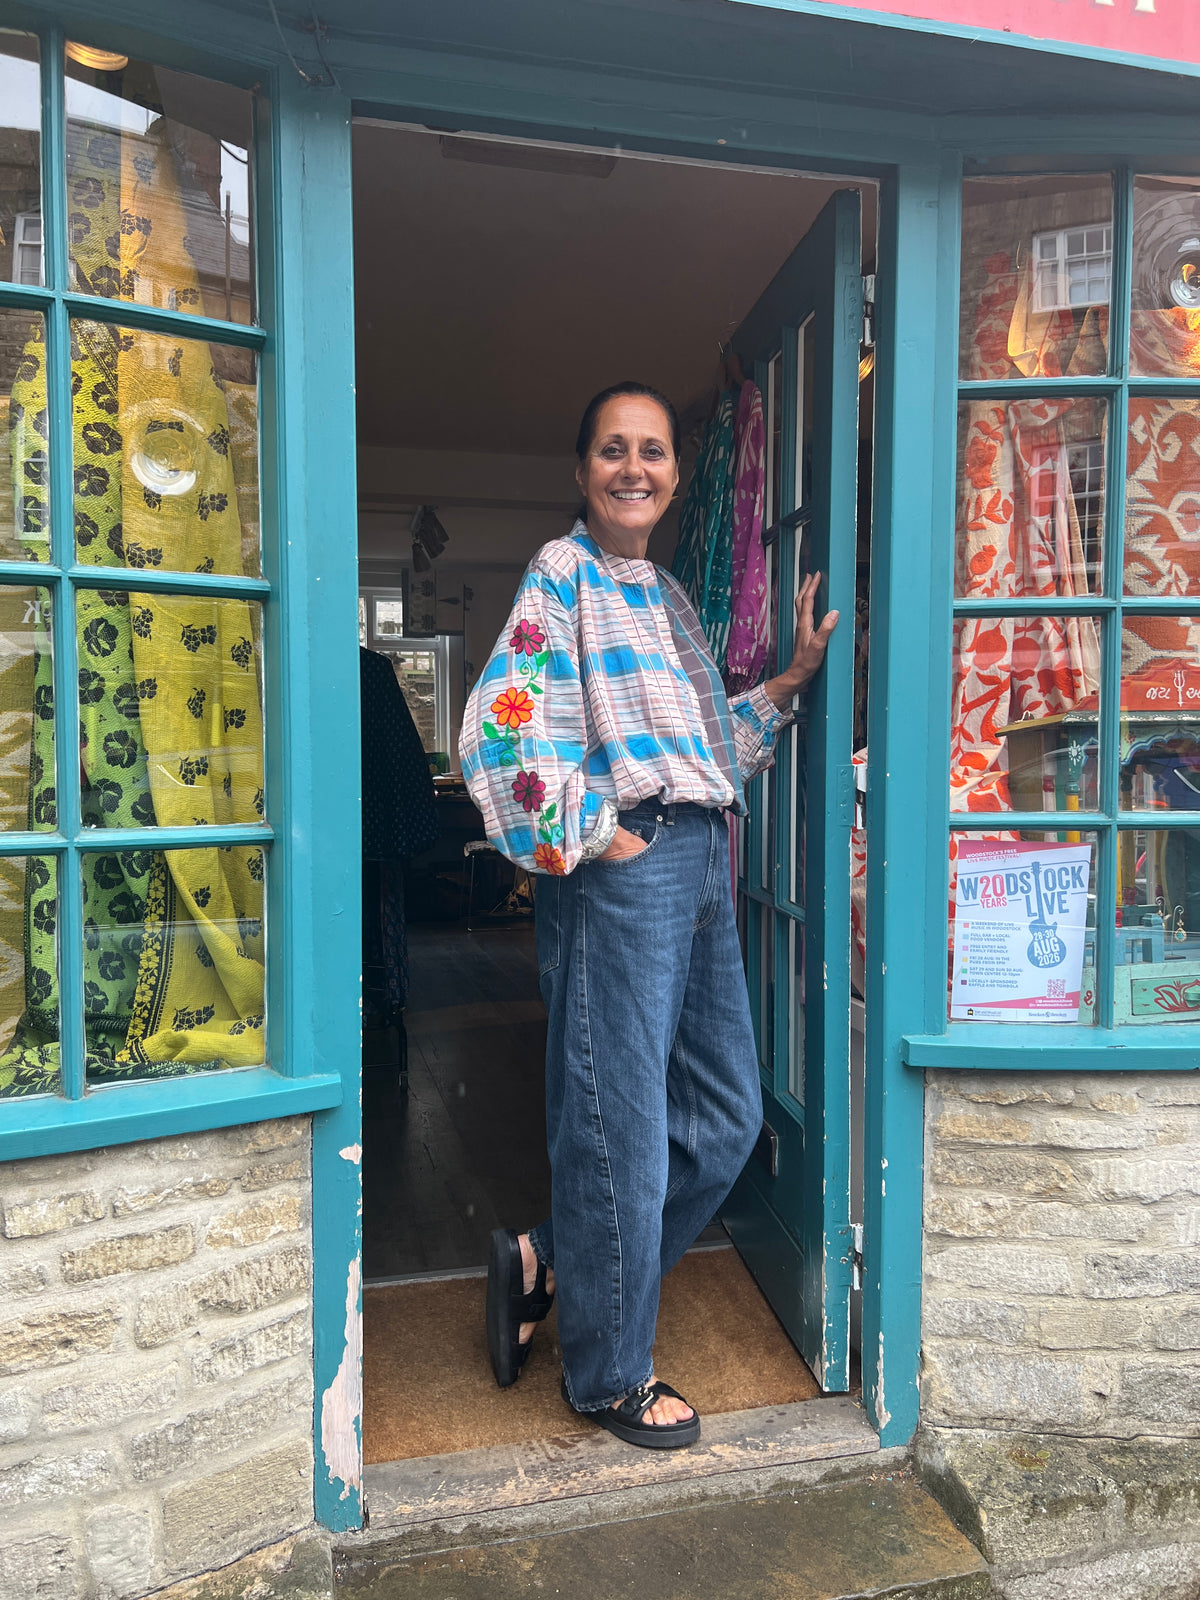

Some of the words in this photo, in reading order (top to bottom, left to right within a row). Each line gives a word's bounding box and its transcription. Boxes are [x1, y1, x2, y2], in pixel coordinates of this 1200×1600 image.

[980, 896, 1008, 909] YEARS
[1025, 890, 1070, 918] LIVE
[1033, 928, 1055, 940] 28-30
[1033, 937, 1060, 957] AUG
[1038, 952, 1060, 966] 2026
